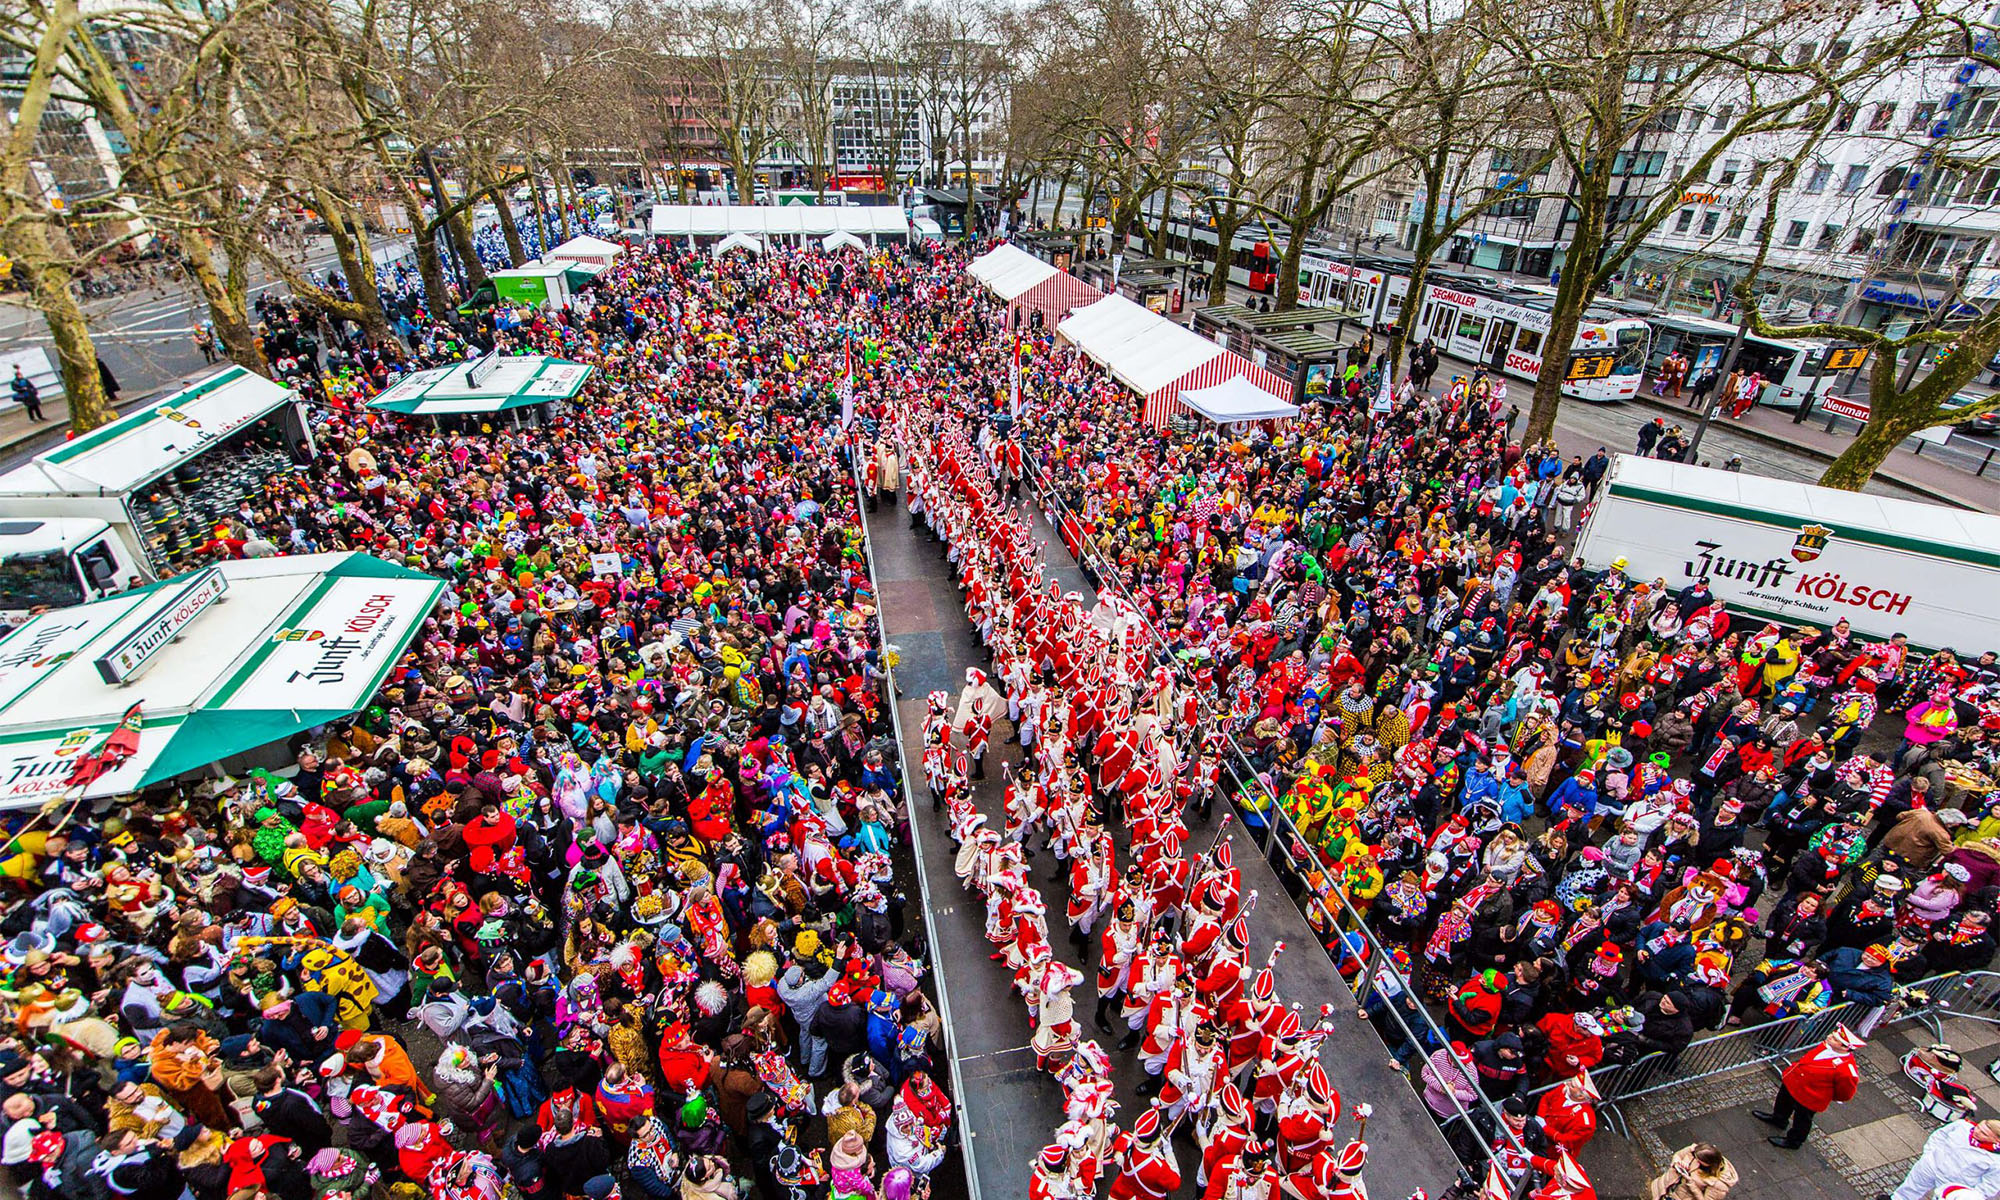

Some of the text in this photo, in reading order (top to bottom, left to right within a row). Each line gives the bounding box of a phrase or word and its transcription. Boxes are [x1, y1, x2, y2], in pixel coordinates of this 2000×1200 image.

[1328, 262, 1361, 278] SEGMÜER
[1431, 287, 1477, 308] SEGMÜLLER
[1505, 353, 1541, 377] SEGM
[1823, 398, 1870, 420] Neumar
[1684, 540, 1912, 616] Zunft KÖLSCH
[173, 588, 213, 626] KÖLSCH
[1760, 593, 1794, 606] zünftige
[1793, 599, 1830, 613] Schluck!
[286, 594, 396, 686] Zunft KÖLSCH
[9, 778, 67, 795] KÖLSC
